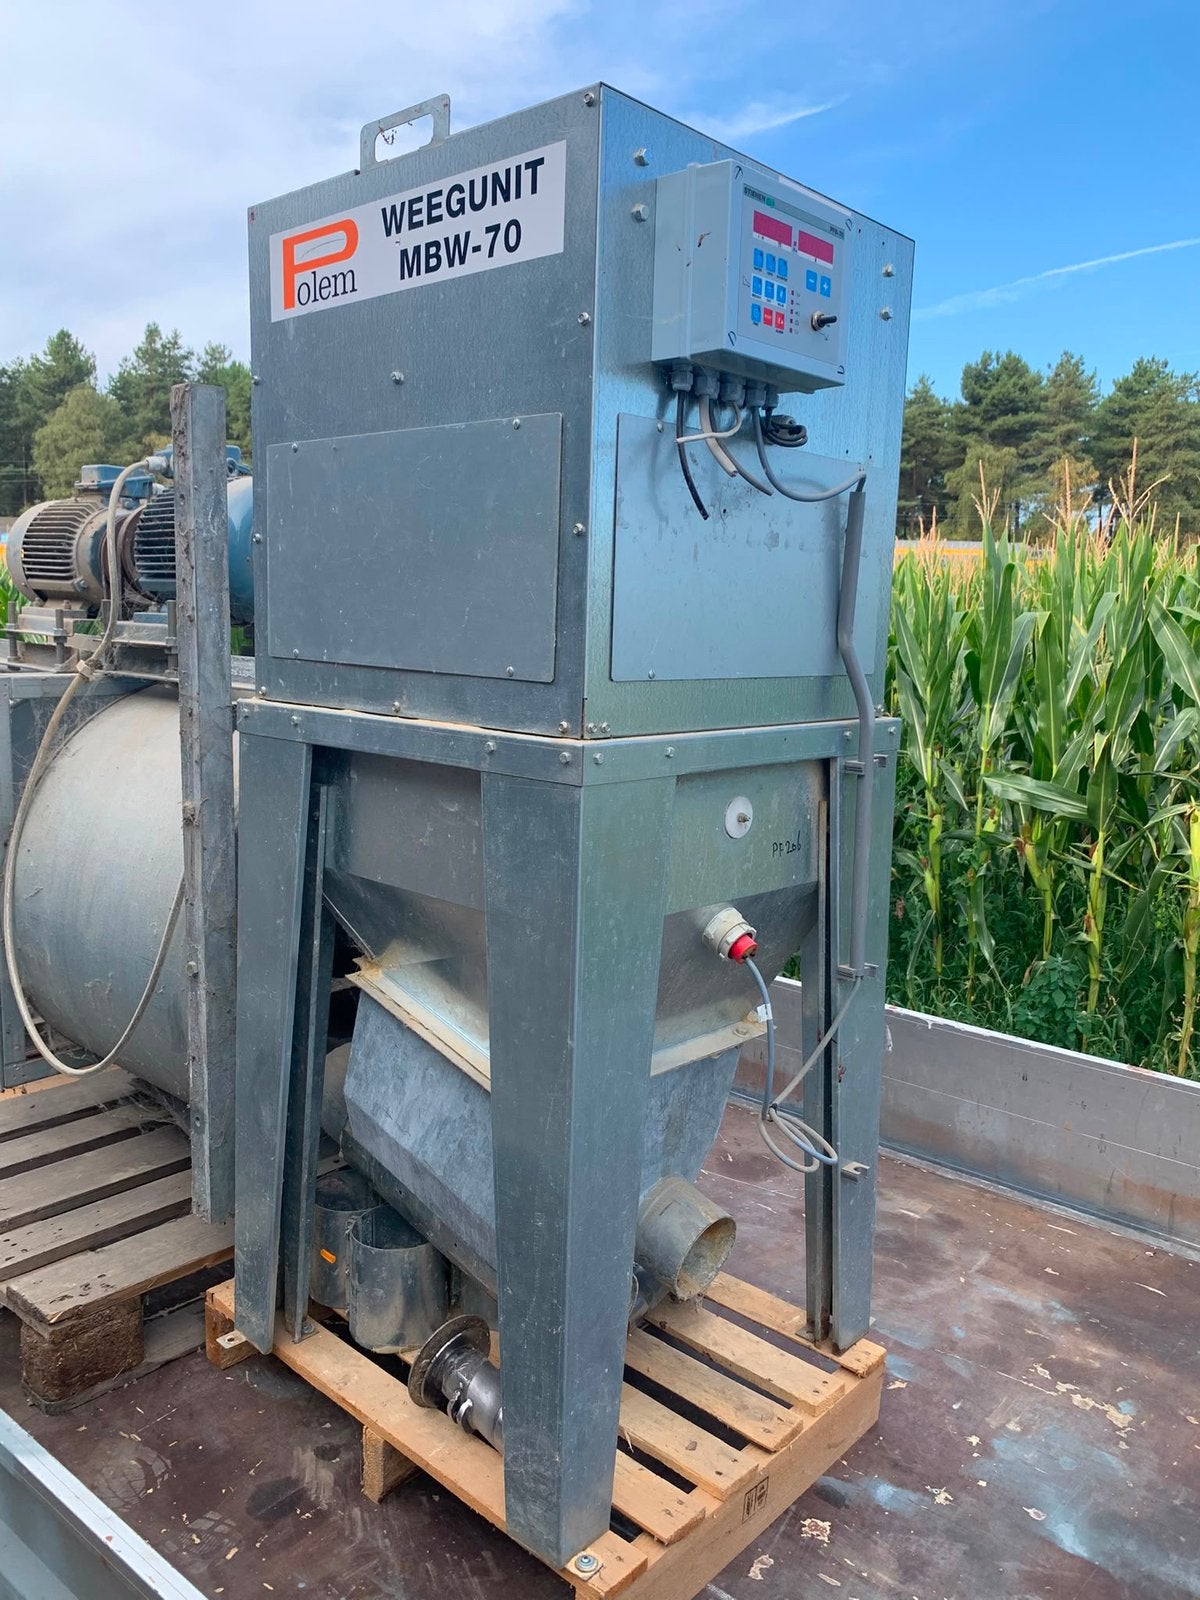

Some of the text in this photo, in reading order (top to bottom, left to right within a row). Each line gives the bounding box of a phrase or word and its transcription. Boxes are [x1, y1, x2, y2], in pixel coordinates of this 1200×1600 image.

[381, 157, 545, 238] WEEGUNIT
[282, 218, 359, 310] Polem
[399, 218, 522, 280] MBW-70
